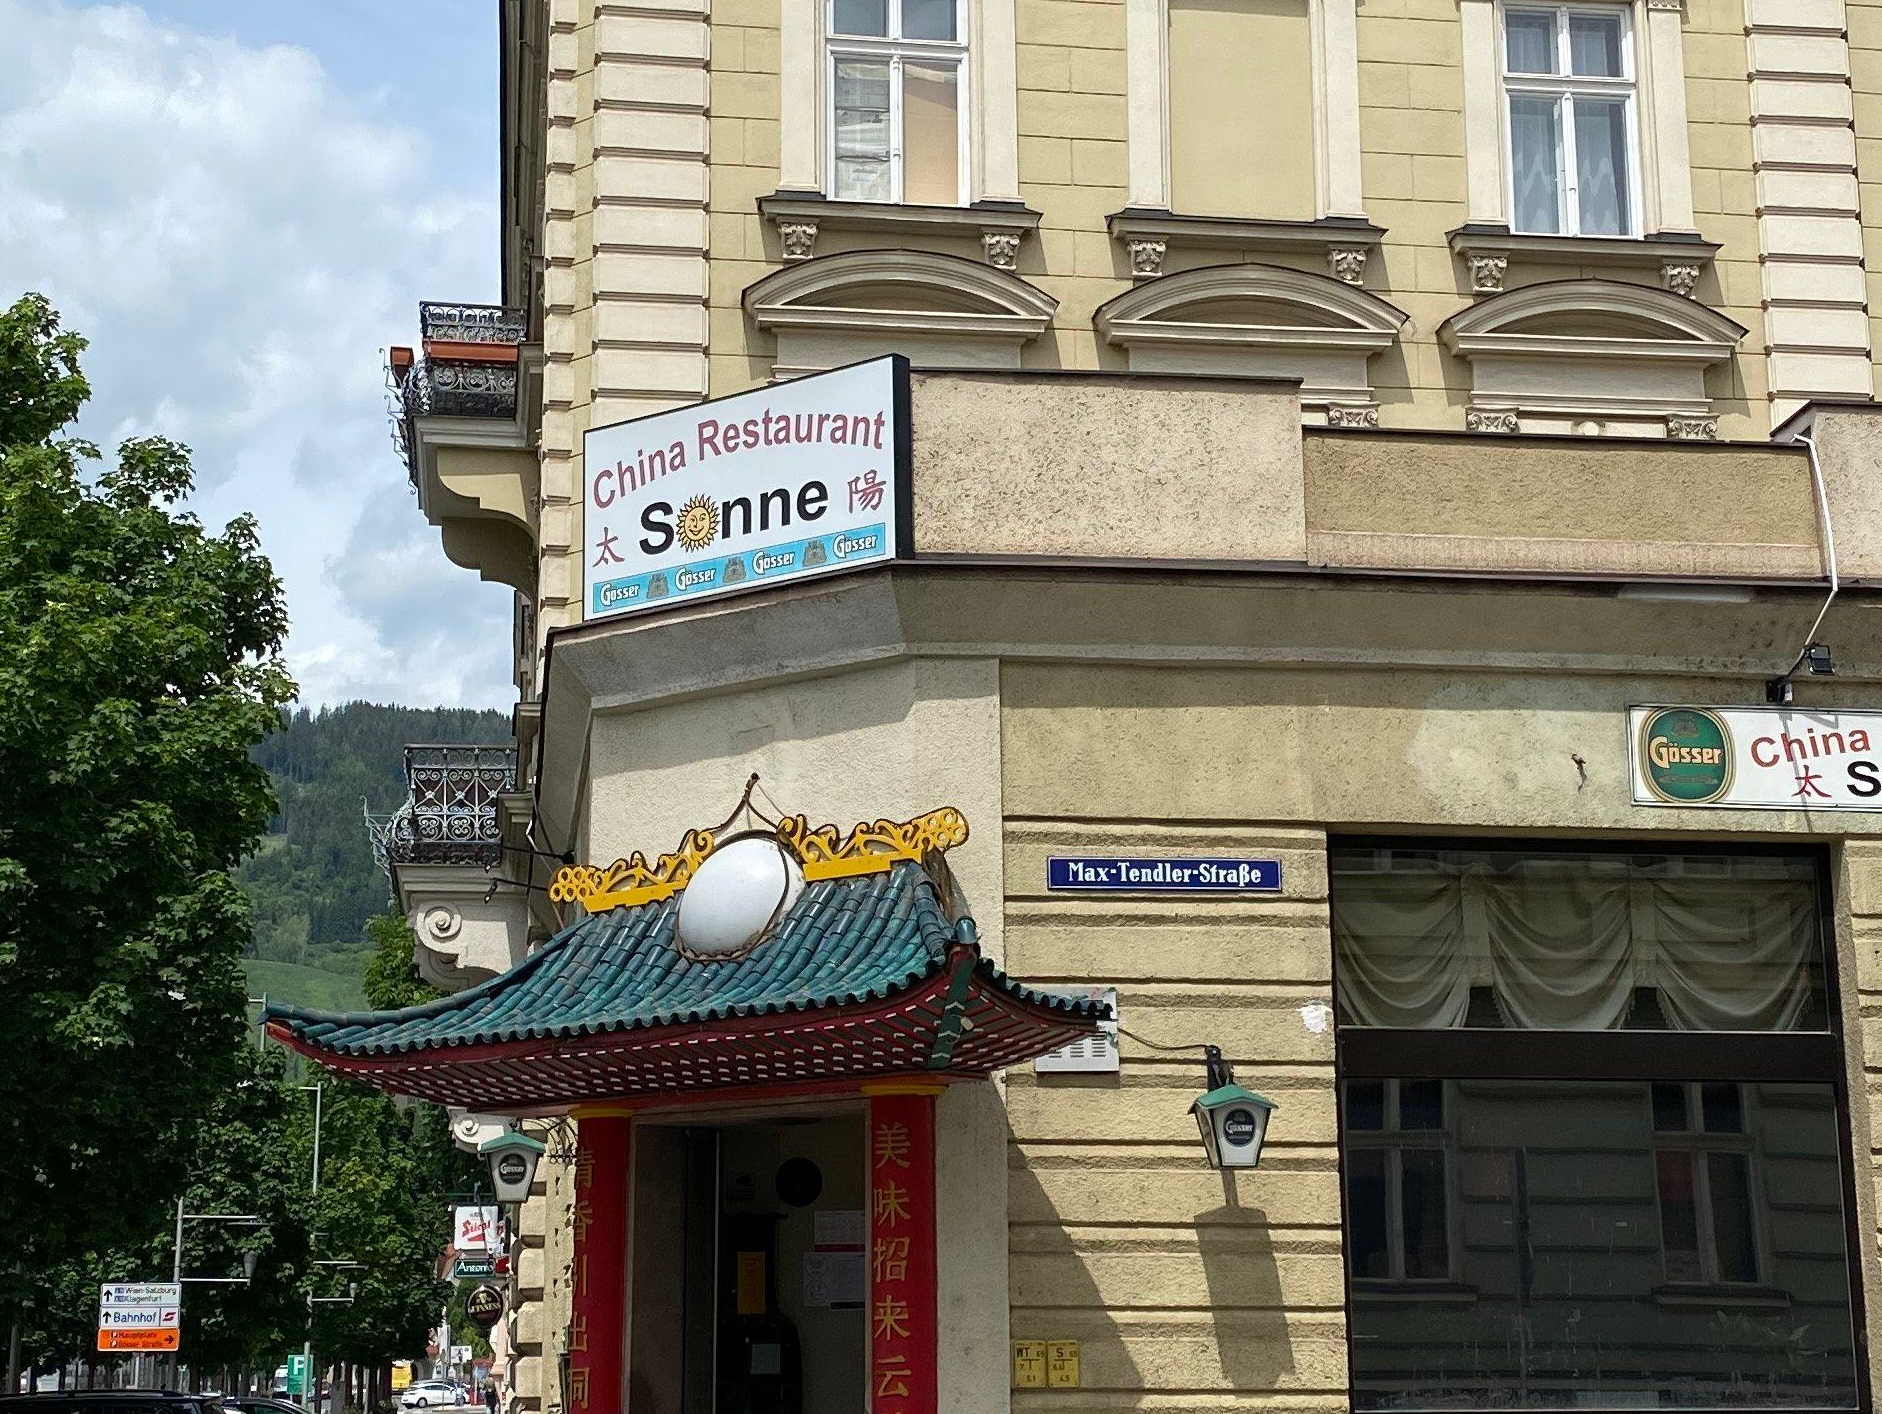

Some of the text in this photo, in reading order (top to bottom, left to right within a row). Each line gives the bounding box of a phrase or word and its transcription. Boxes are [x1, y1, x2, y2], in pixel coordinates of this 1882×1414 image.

[593, 407, 886, 509] China Restaurant
[847, 469, 887, 514] 陽
[592, 526, 625, 568] 太
[600, 533, 878, 607] Gösser Gösser Gösser Gösser
[1649, 736, 1722, 769] Gösser
[1750, 727, 1872, 768] China
[1791, 764, 1833, 799] 太
[1068, 861, 1262, 887] Max-Tendler-Straße
[113, 1311, 157, 1323] Bahnhof
